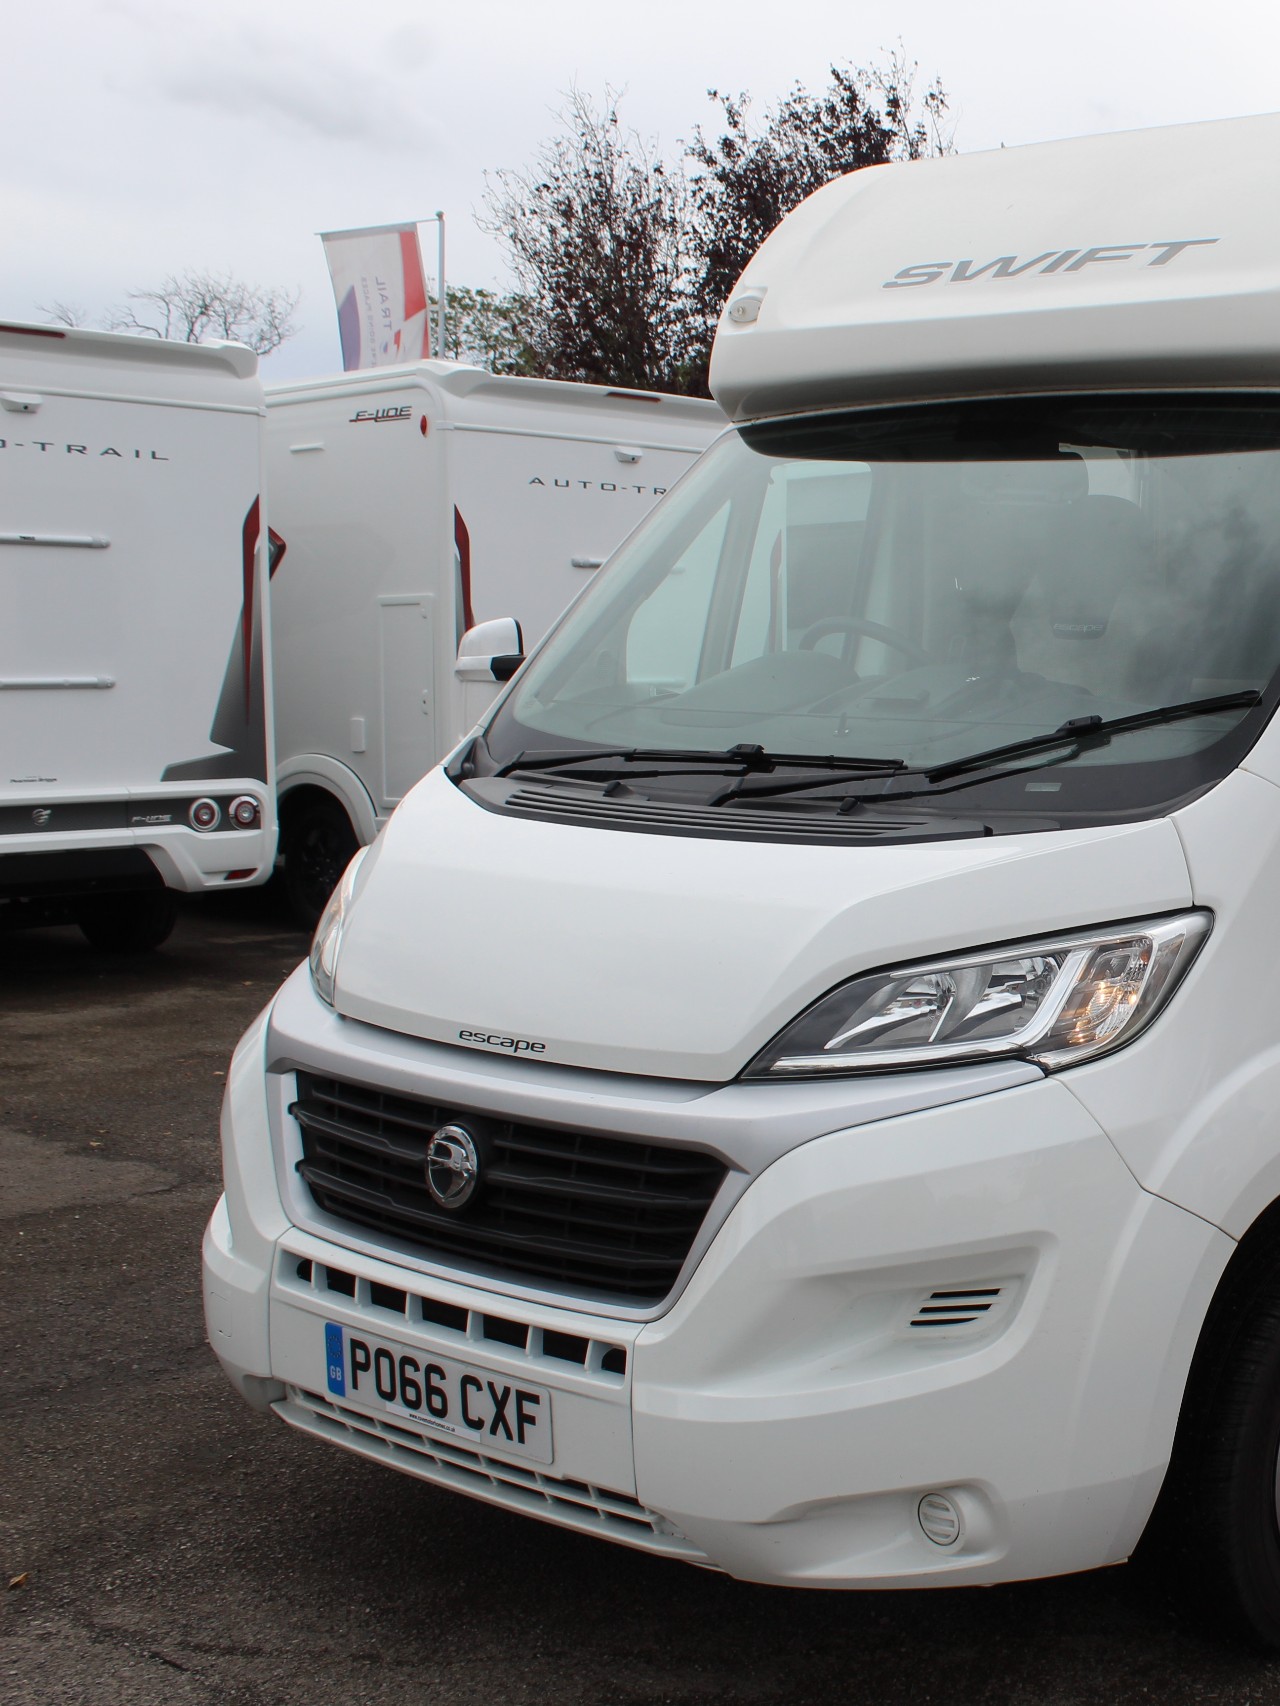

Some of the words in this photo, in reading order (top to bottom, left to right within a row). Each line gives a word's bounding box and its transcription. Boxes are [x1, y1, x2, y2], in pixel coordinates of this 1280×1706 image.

[882, 237, 1221, 289] SWIFT
[459, 1029, 547, 1053] escape
[329, 1365, 342, 1381] GB
[350, 1337, 448, 1419] PO66
[460, 1374, 541, 1445] CXF
